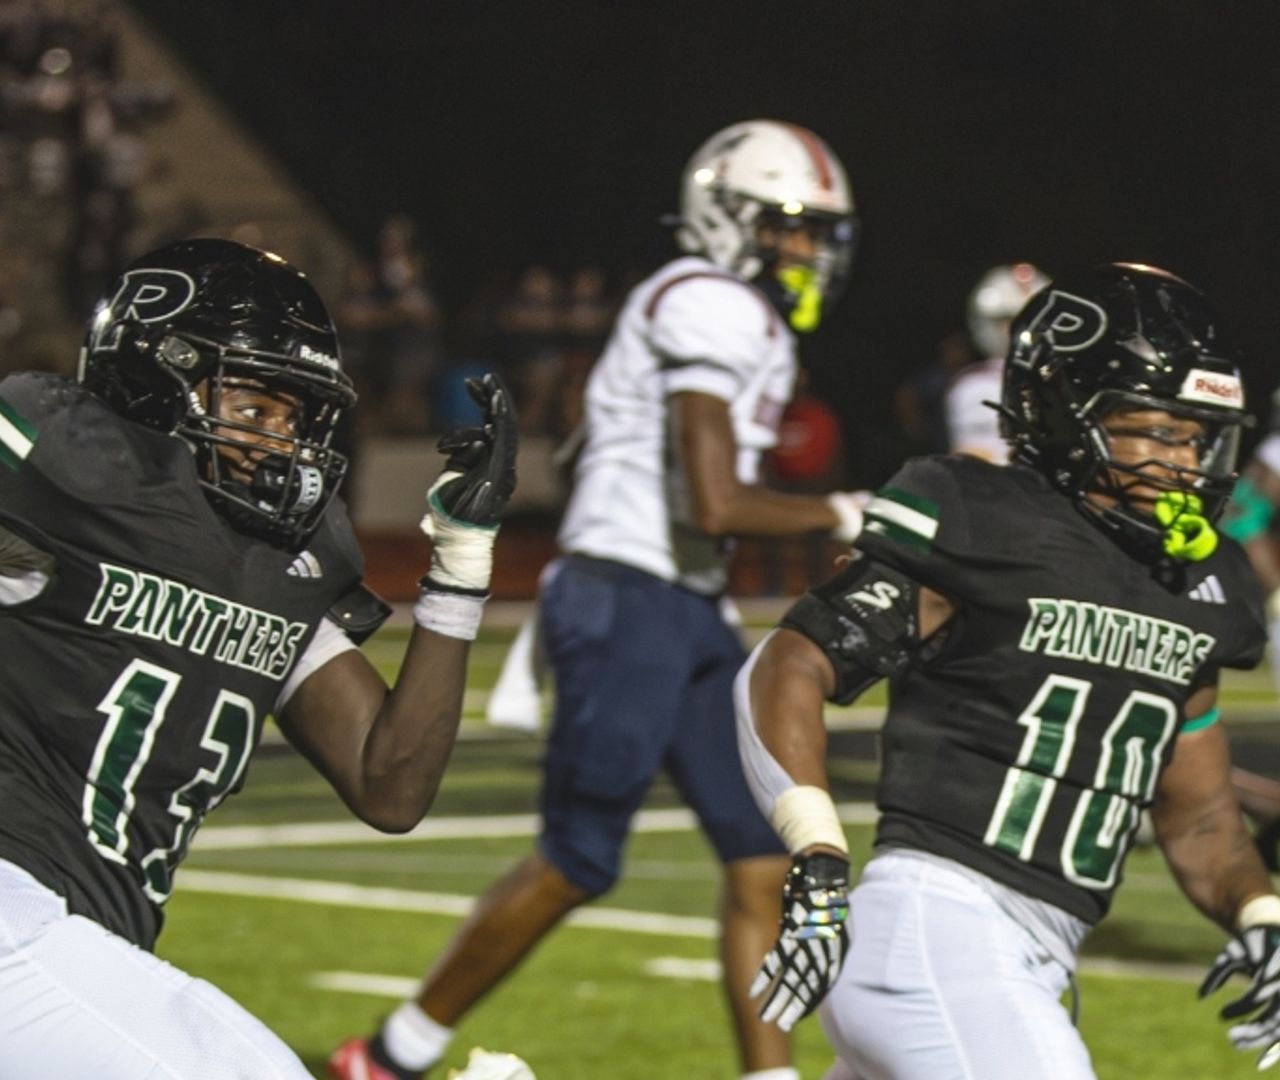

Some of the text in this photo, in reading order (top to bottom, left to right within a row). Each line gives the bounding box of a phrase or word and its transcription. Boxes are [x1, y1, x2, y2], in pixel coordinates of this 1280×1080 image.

[93, 267, 195, 353] P
[1013, 289, 1109, 370] P
[84, 561, 309, 682] PANTHERS
[1018, 597, 1217, 685] PANTHERS
[82, 657, 257, 906] 13
[981, 673, 1179, 891] 10
